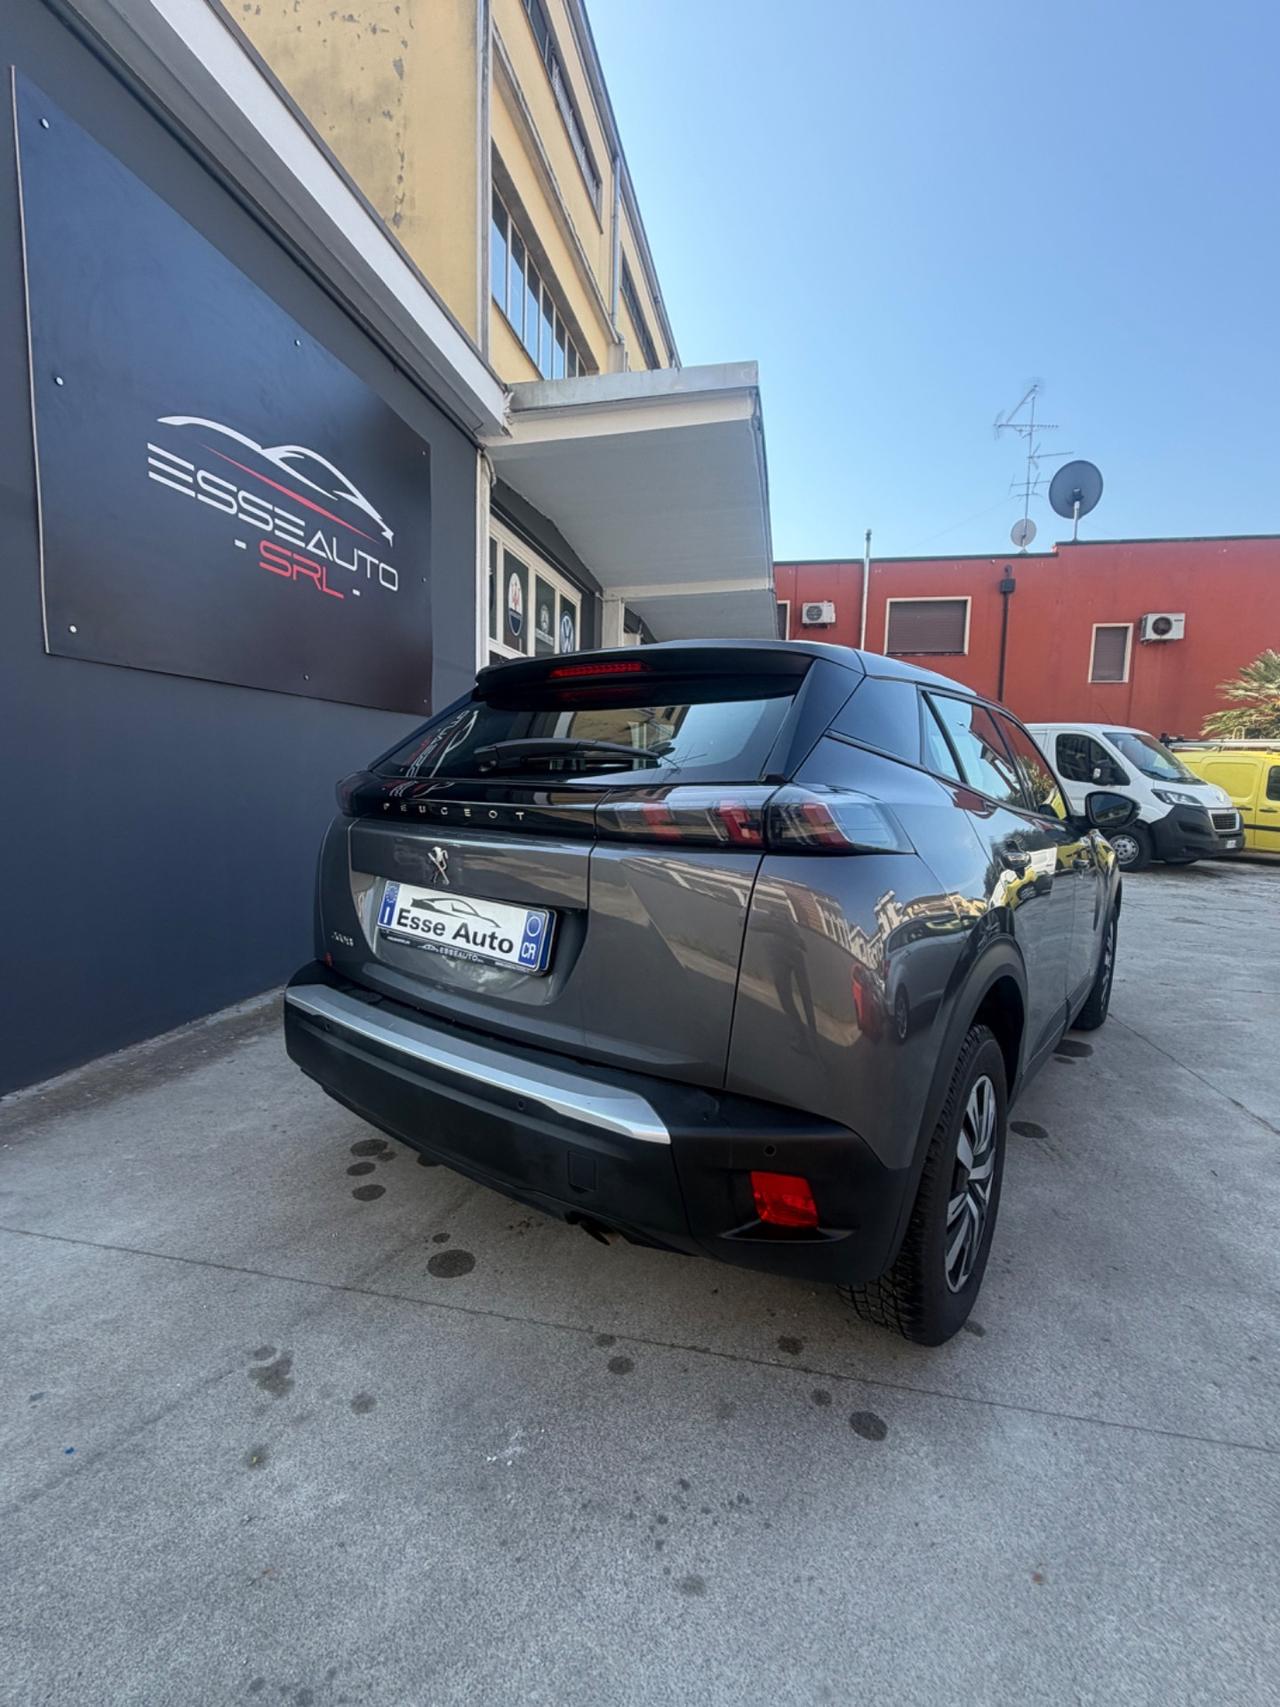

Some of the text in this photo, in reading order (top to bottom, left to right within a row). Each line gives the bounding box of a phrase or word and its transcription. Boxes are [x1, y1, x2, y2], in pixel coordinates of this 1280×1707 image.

[147, 442, 399, 592] ESSEAUTO
[258, 538, 345, 599] SRL
[382, 802, 526, 821] PEUGEOT
[382, 905, 391, 924] I
[396, 907, 515, 955] Esse Auto
[520, 941, 537, 960] CR
